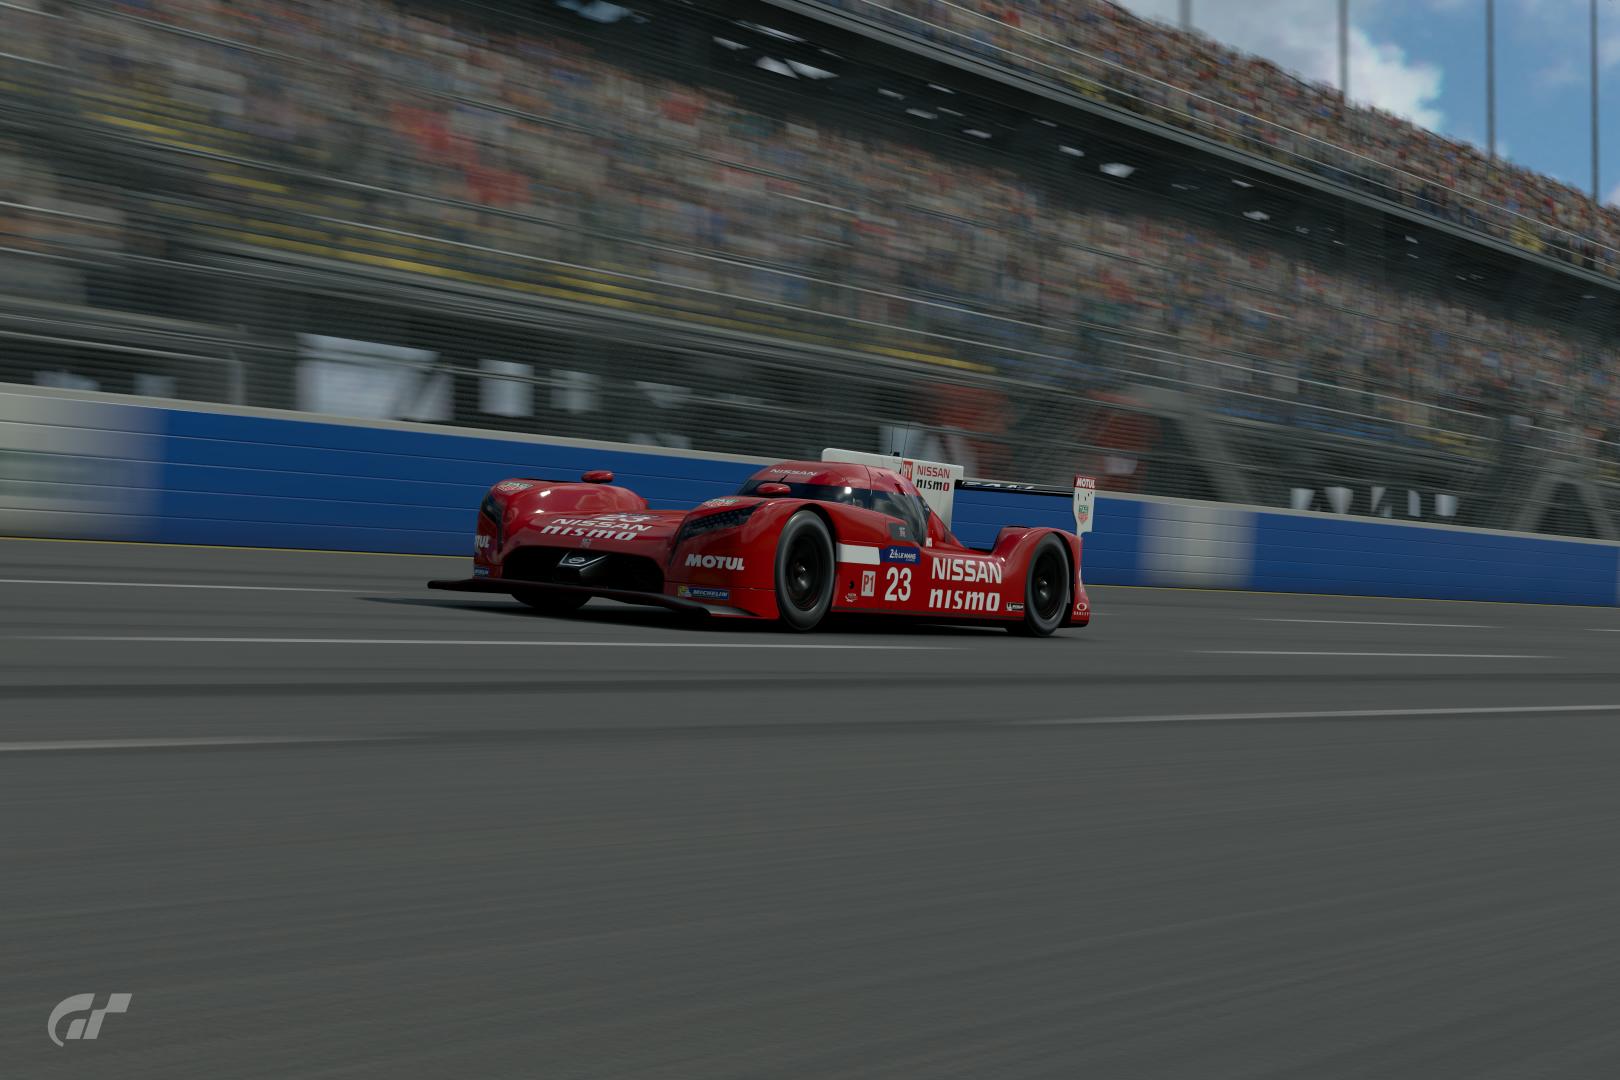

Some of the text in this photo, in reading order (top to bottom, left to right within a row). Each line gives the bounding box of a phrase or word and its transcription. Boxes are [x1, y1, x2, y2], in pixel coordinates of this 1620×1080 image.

[770, 468, 818, 477] NISSAN
[917, 466, 951, 479] NISSAN
[1076, 478, 1096, 489] MOTUL
[552, 518, 652, 531] NISSAN
[685, 553, 745, 571] MOTUL
[931, 557, 1002, 584] NISSAN
[863, 574, 875, 593] P1
[884, 566, 912, 601] 23
[928, 588, 1001, 612] nismo
